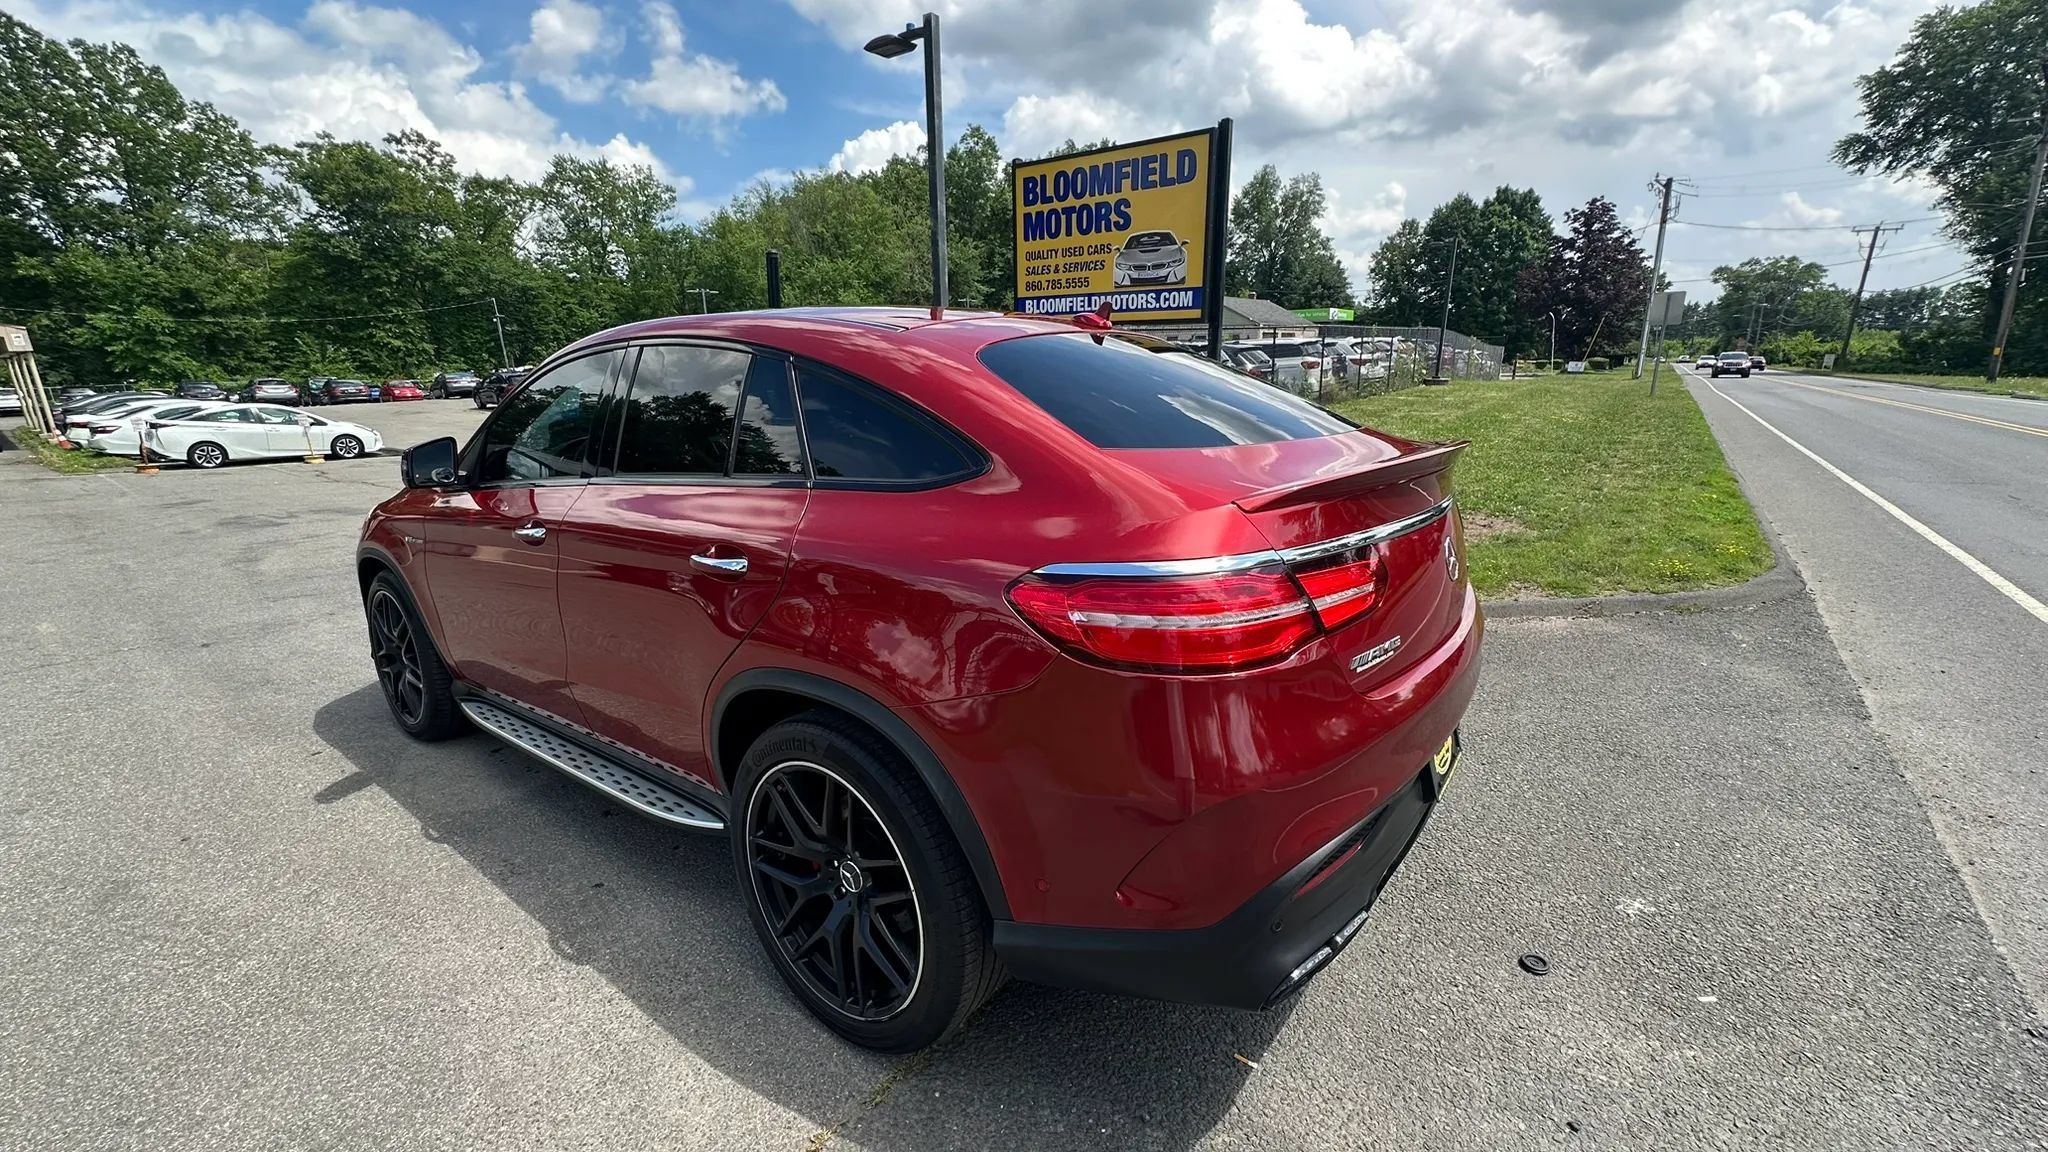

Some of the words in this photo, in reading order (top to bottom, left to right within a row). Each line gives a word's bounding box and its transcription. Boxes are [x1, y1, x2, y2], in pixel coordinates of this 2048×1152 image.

[1022, 148, 1197, 207] BLOOMFIELD
[1023, 197, 1132, 242] MOTORS
[1025, 248, 1059, 262] QUALITY
[1061, 246, 1084, 258] USED
[1087, 243, 1112, 255] CARS
[1025, 264, 1051, 276] SALES
[1053, 264, 1060, 273] &
[1062, 260, 1105, 273] SERVICES
[1025, 276, 1090, 292] 860.785.5555
[751, 736, 808, 767] Continental
